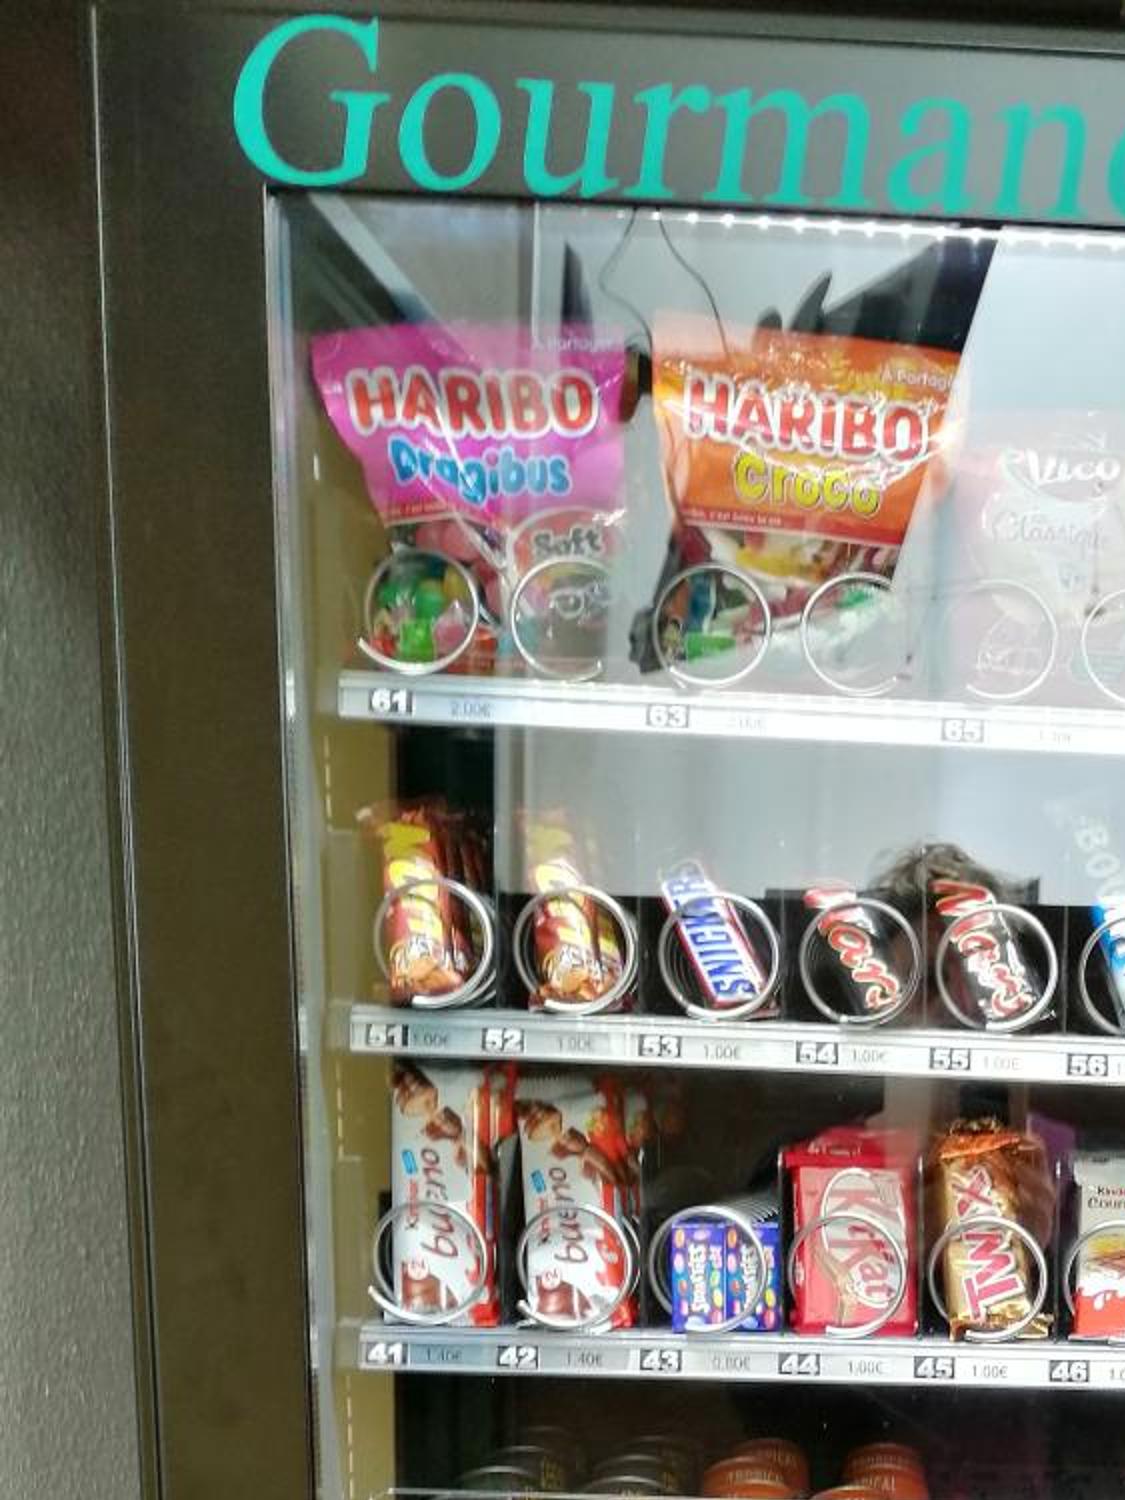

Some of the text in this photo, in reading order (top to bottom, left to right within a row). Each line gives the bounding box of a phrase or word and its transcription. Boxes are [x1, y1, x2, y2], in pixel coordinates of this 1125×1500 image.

[345, 365, 601, 440] HARIBO
[682, 374, 931, 462] HARIBO
[387, 437, 571, 507] Dragibus
[731, 445, 884, 519] Croco
[369, 688, 412, 716] 61
[649, 704, 689, 728] 63
[940, 719, 982, 742] 65
[366, 1023, 408, 1046] 51
[485, 1028, 523, 1052] 52
[642, 1036, 680, 1058] 53
[799, 1042, 837, 1065] 54
[932, 1048, 969, 1070] 55
[1069, 1054, 1106, 1076] 56
[952, 1165, 1026, 1323] TWX
[366, 1341, 404, 1365] 41
[499, 1345, 537, 1370] 42
[642, 1350, 680, 1372] 43
[780, 1354, 819, 1376] 44
[916, 1357, 1008, 1380] 45 1.00€
[1051, 1361, 1088, 1382] 46
